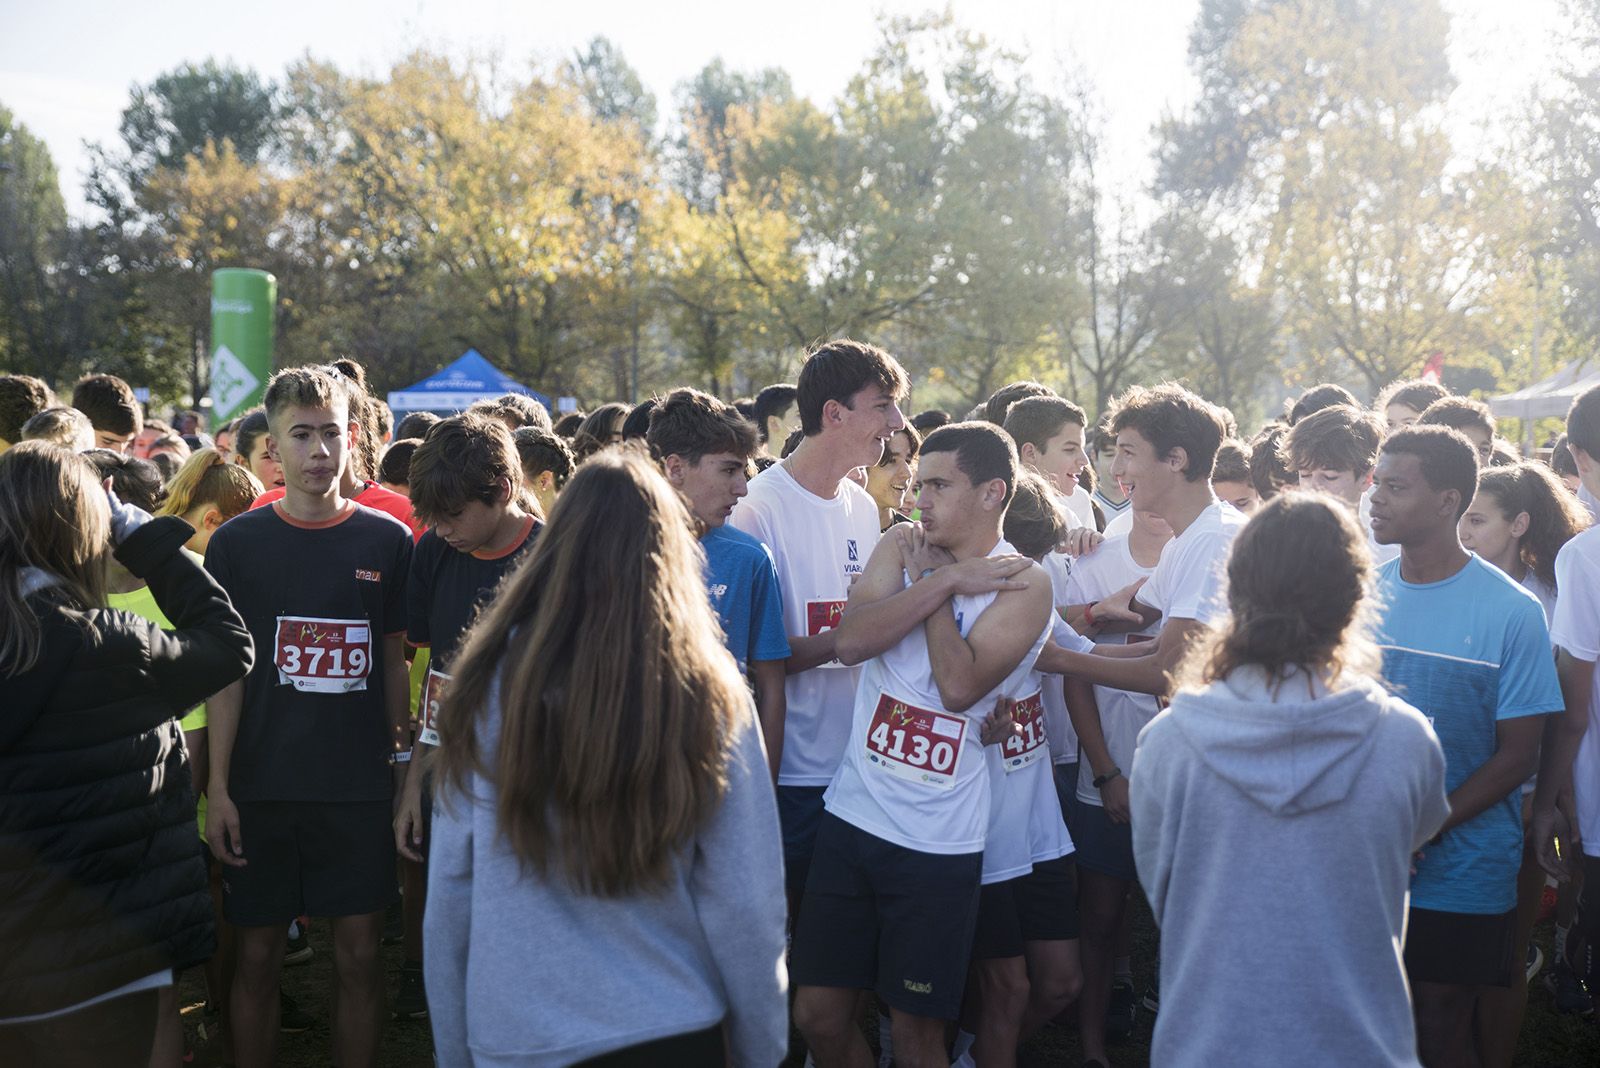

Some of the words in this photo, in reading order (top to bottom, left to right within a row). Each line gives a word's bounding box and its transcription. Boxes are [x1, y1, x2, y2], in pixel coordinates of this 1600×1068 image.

[844, 565, 862, 573] VIAR
[281, 645, 367, 677] 3719
[870, 722, 954, 772] 4130
